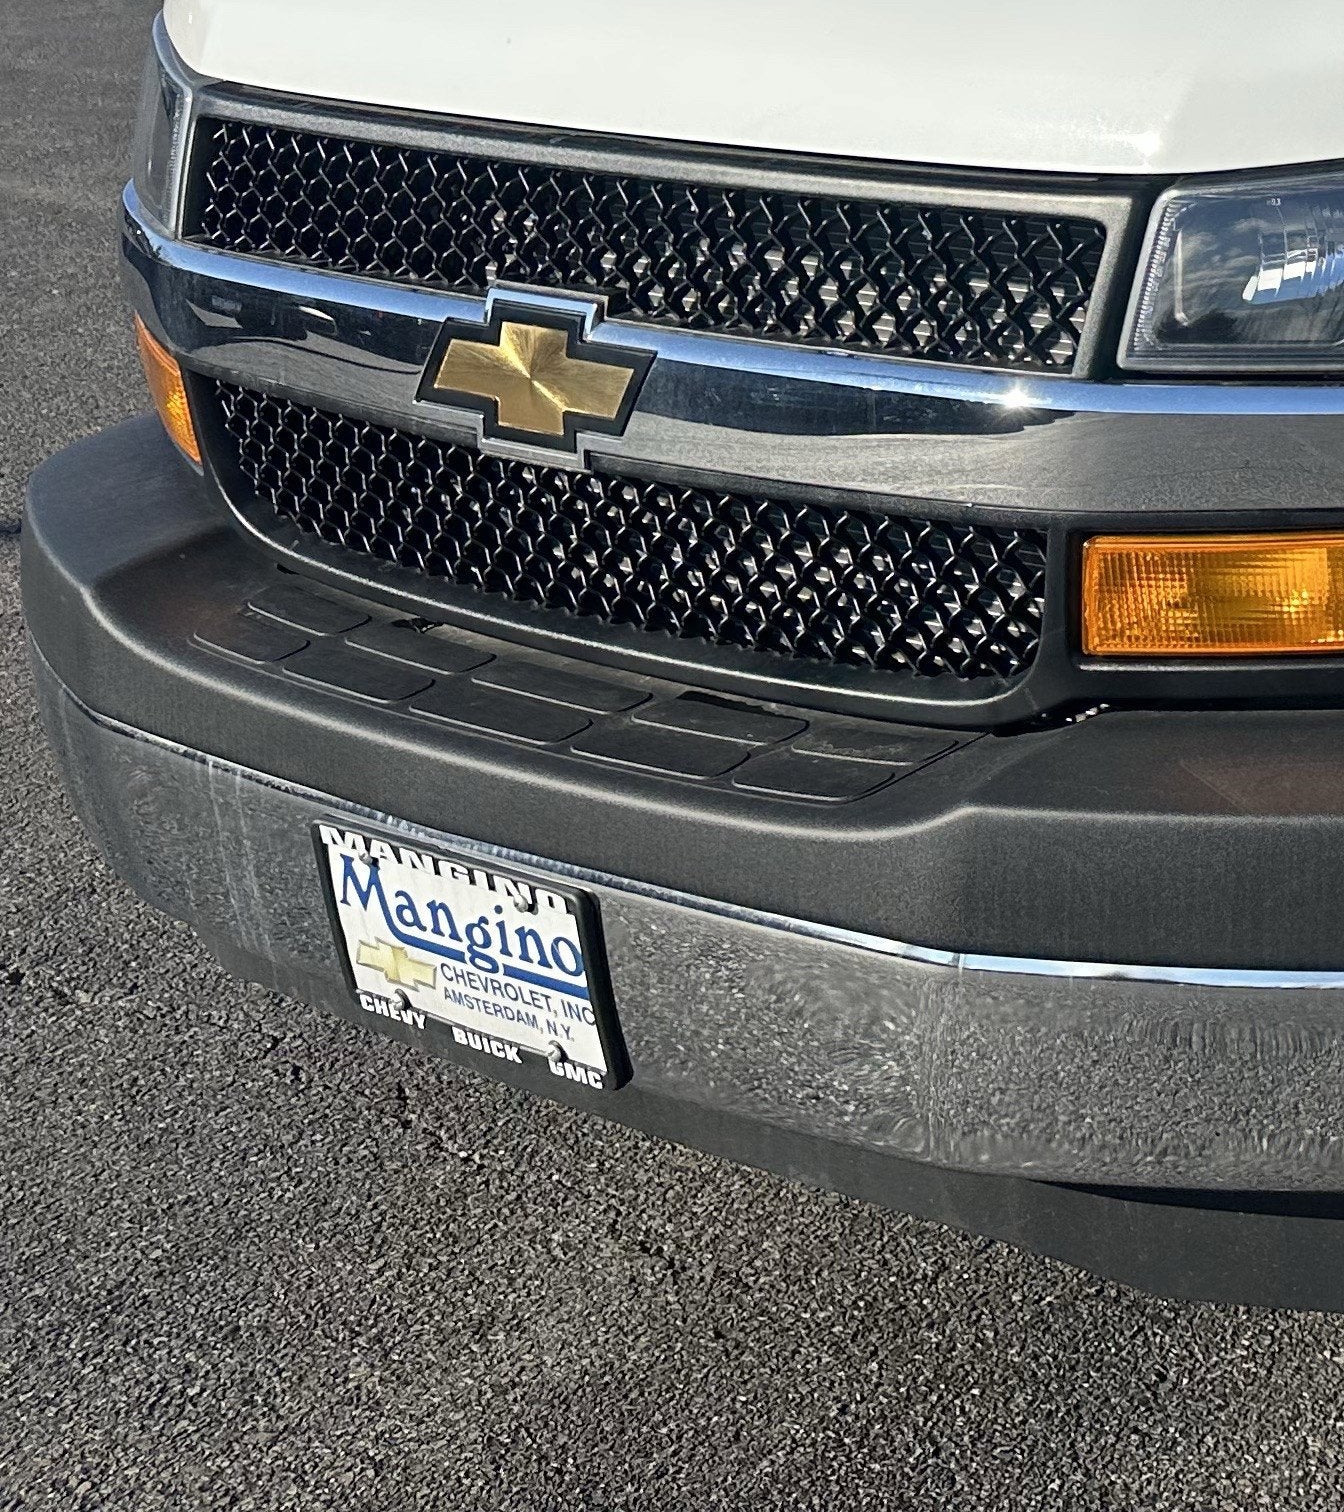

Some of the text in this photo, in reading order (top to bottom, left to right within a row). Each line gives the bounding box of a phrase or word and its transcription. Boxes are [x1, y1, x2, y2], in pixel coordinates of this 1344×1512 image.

[318, 824, 570, 916] MANGINO
[339, 853, 585, 977] Mangino
[359, 993, 427, 1030] CHEVY
[440, 962, 558, 1018] CHEVROLET,
[443, 986, 544, 1035] AMSTERDAM,
[451, 1025, 523, 1065] BUICK
[547, 1054, 604, 1090] GMC
